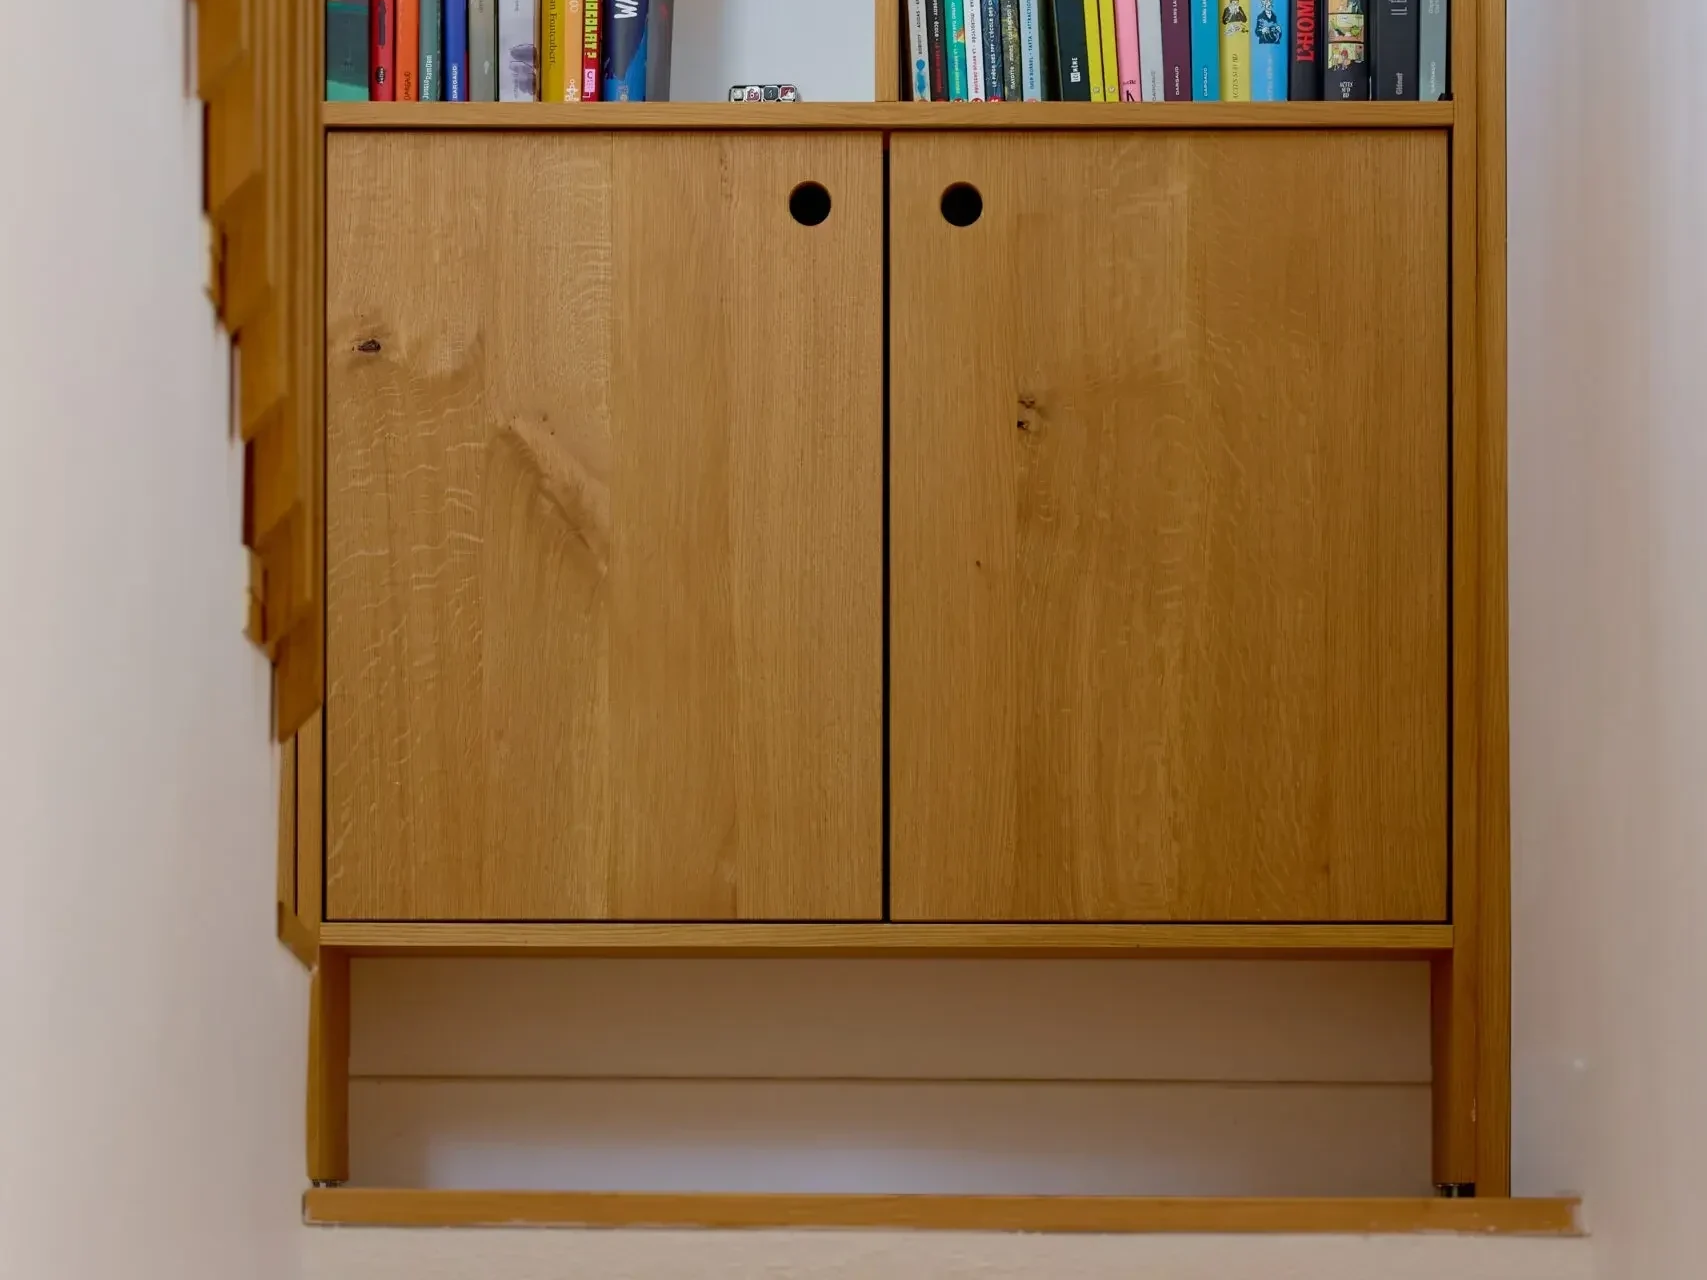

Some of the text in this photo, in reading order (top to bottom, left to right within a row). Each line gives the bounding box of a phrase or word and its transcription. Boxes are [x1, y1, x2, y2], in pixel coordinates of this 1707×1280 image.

[1390, 6, 1407, 16] IL
[549, 13, 558, 69] Fontcubert
[1395, 72, 1404, 95] Glénat
